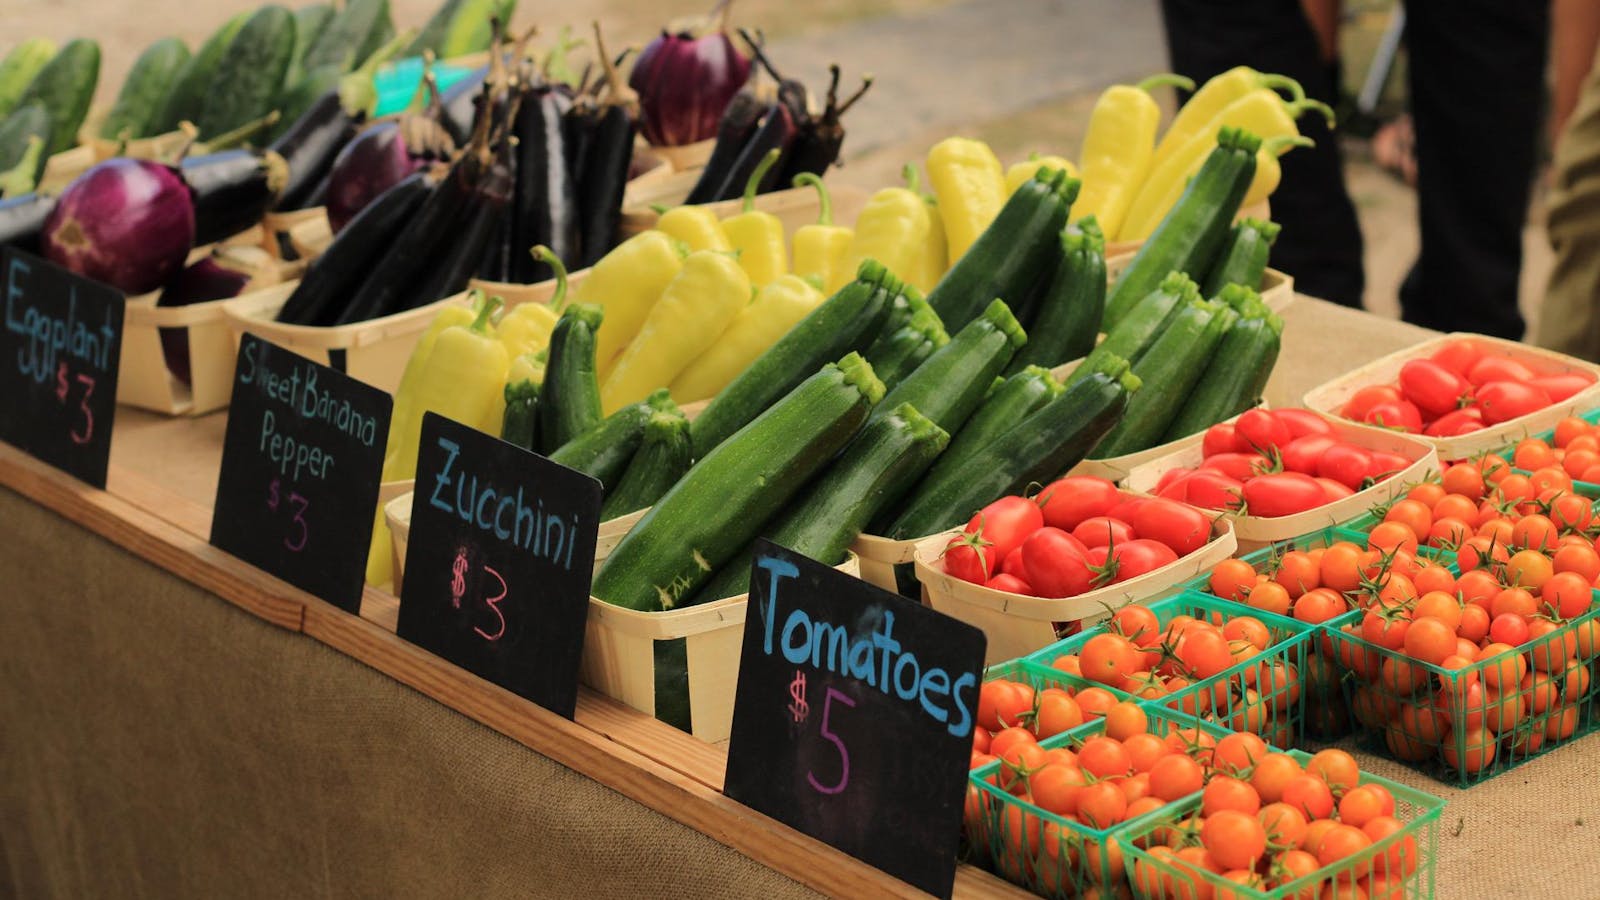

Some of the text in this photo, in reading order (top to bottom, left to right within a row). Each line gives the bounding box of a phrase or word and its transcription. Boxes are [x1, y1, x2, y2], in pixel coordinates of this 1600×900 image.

[5, 256, 116, 384] Eggplant
[259, 409, 336, 482] Pepper
[302, 364, 377, 448] Banana
[429, 436, 579, 571] Zucchini
[757, 556, 976, 739] Tomatoes
